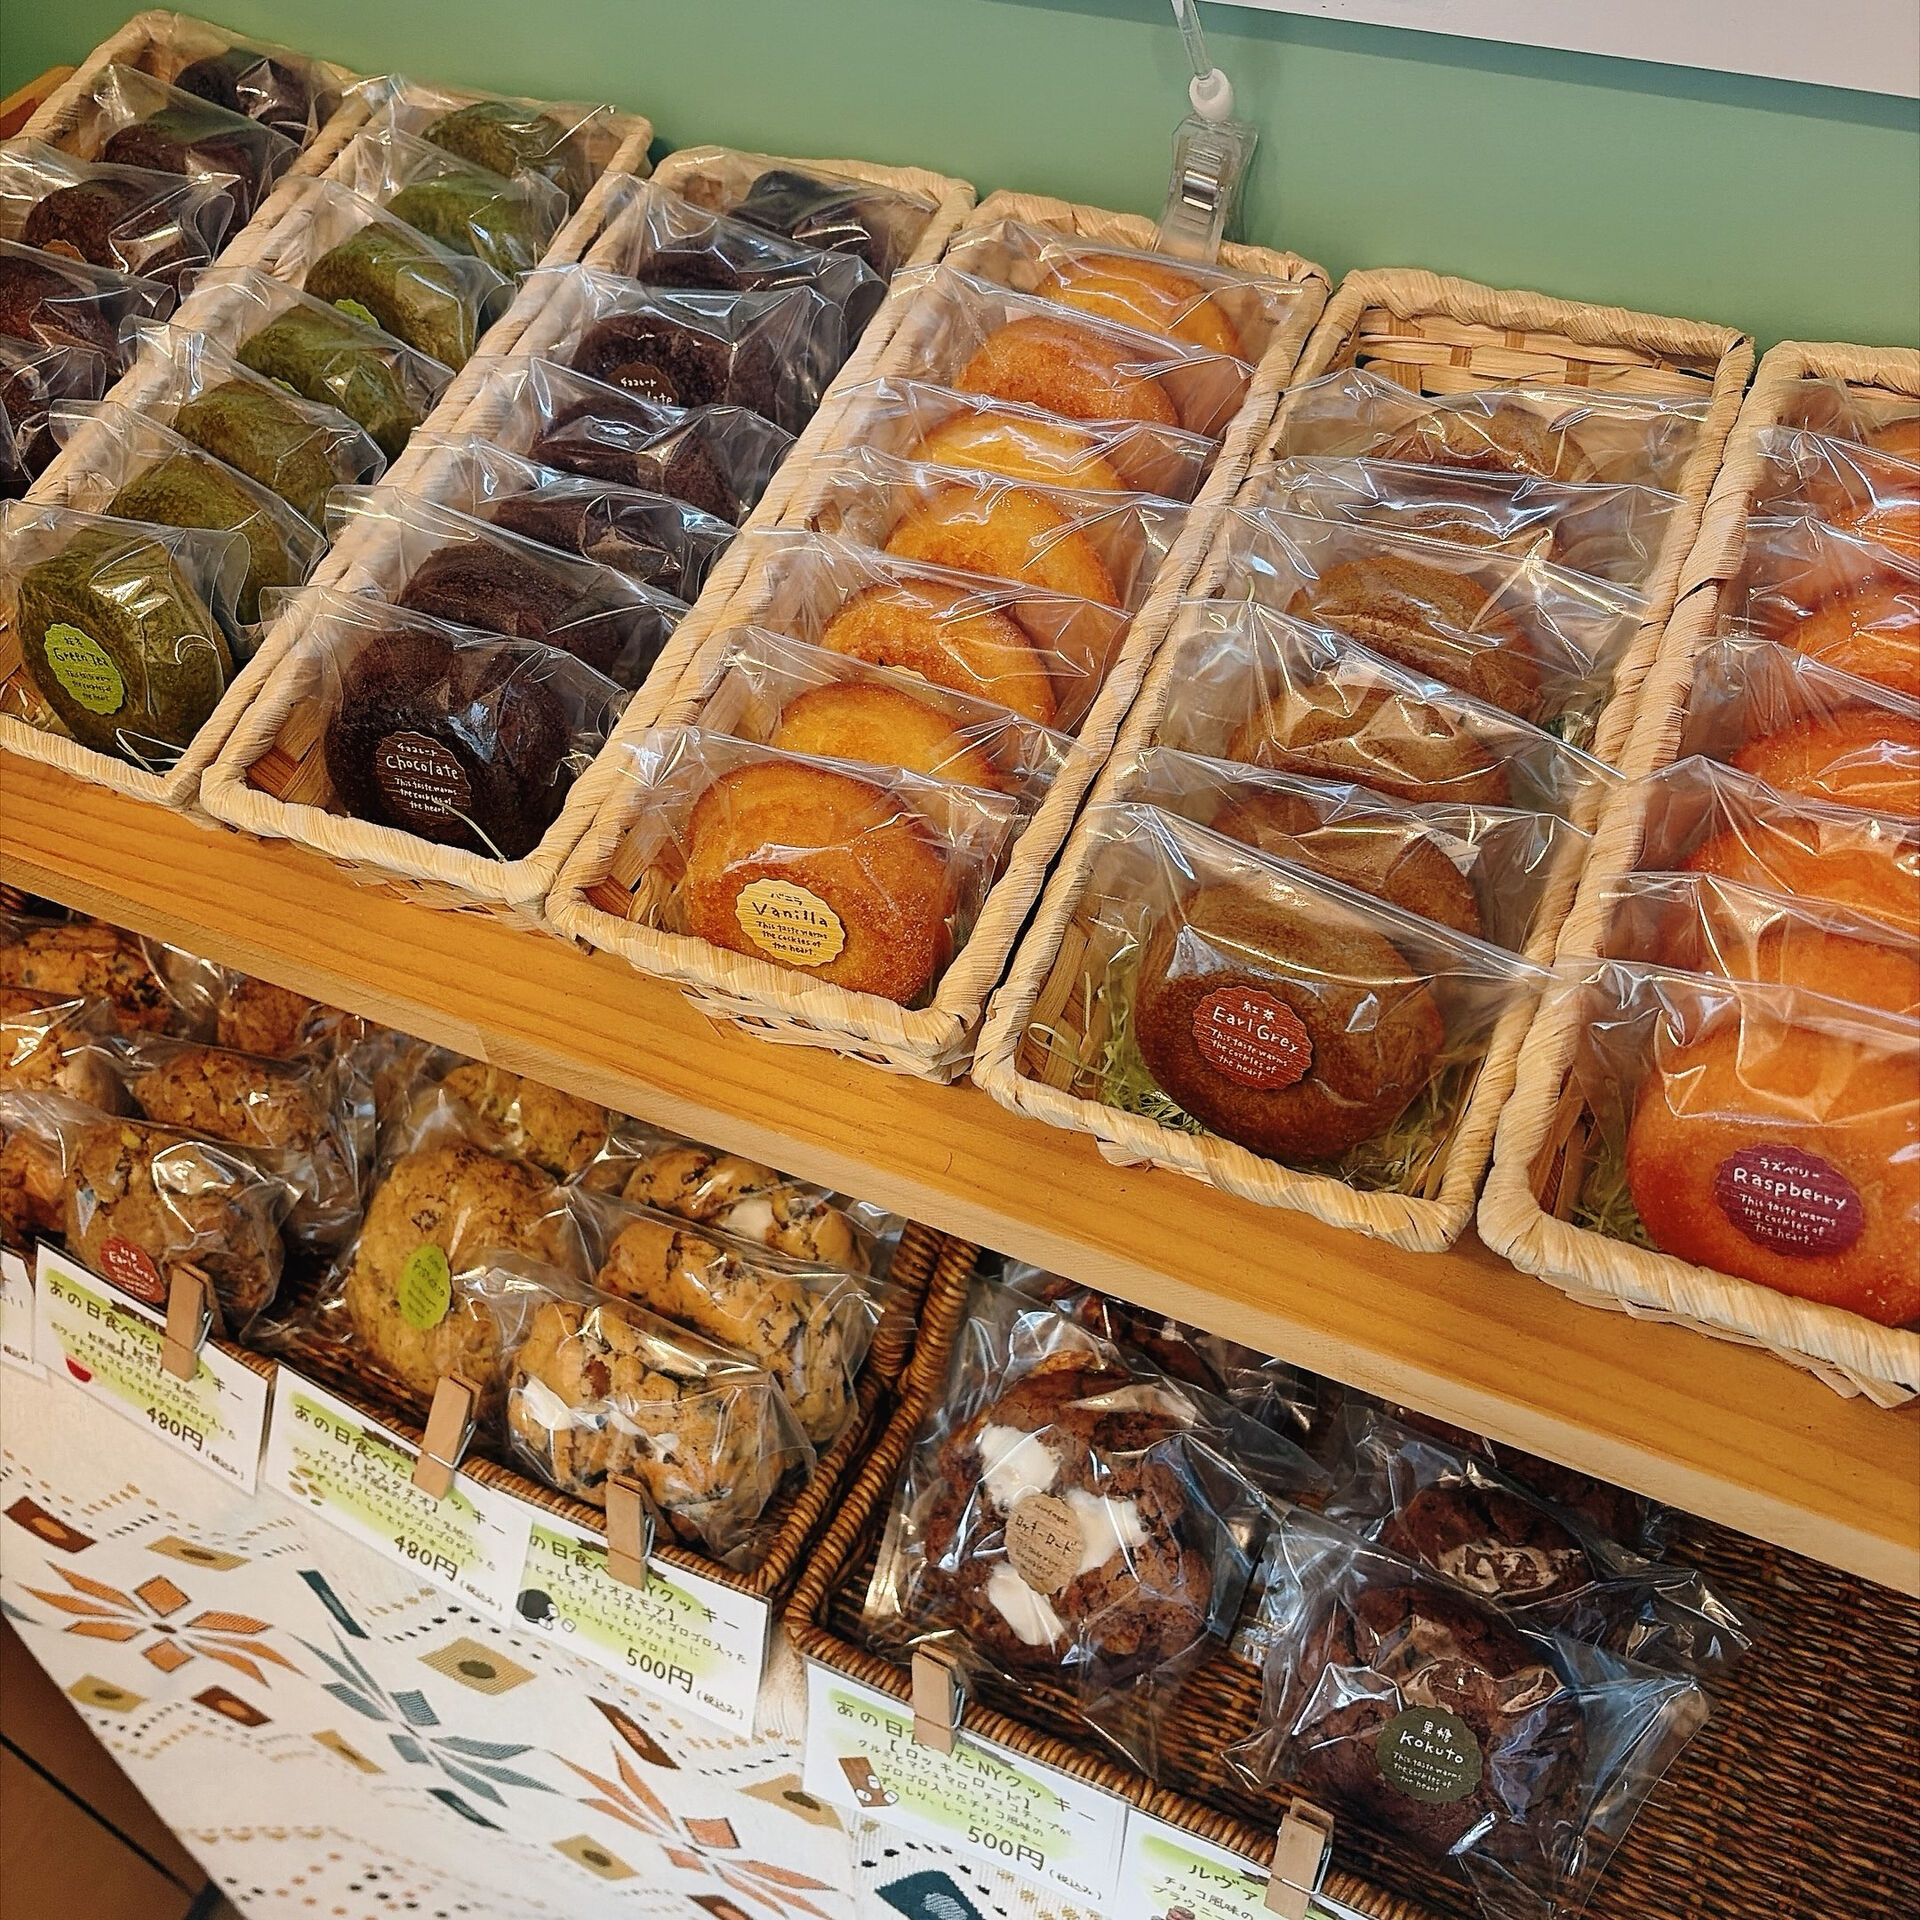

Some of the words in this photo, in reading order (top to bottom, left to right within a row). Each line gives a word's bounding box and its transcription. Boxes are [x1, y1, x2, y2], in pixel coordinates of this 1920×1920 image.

[53, 647, 87, 662] Green
[86, 651, 109, 667] Tea
[386, 755, 459, 780] Chocolate
[394, 777, 411, 787] This
[412, 781, 432, 791] taste
[433, 786, 457, 796] warms
[400, 788, 413, 798] the
[409, 800, 422, 810] the
[770, 892, 803, 906] バニラ
[752, 901, 828, 928] Vanilla
[756, 920, 775, 930] This
[777, 924, 799, 935] taste
[800, 929, 828, 940] warms
[762, 930, 775, 939] the
[778, 932, 811, 946] cockles
[812, 940, 821, 948] of
[772, 942, 786, 951] the
[1242, 1000, 1276, 1023] 紅茶
[1212, 1005, 1253, 1032] Earl
[1256, 1024, 1299, 1053] Grey
[1210, 1028, 1231, 1042] This
[1232, 1036, 1257, 1054] taste
[1259, 1049, 1288, 1067] warms
[1211, 1040, 1227, 1052] the
[1228, 1047, 1264, 1069] cockles
[1265, 1065, 1277, 1074] of
[1218, 1054, 1233, 1067] the
[1759, 1157, 1820, 1178] ラズベリー
[1733, 1166, 1847, 1210] Raspberry
[1740, 1193, 1764, 1207] This
[1767, 1200, 1796, 1216] taste
[1799, 1211, 1837, 1226] warms
[1744, 1207, 1761, 1219] the
[1764, 1213, 1808, 1233] cockles
[1812, 1226, 1825, 1236] of
[1754, 1222, 1773, 1235] the
[1777, 1229, 1814, 1246] heart.
[147, 1406, 204, 1451] 480円
[394, 1535, 458, 1581] 480円
[627, 1646, 693, 1694] 500円
[1421, 1720, 1453, 1744] 黒糖
[1399, 1730, 1464, 1764] Kokuto
[1393, 1751, 1410, 1763] This
[1412, 1759, 1434, 1771] taste
[1435, 1767, 1462, 1782] warms
[1393, 1762, 1407, 1773] the
[1408, 1769, 1440, 1785] cockles
[1442, 1780, 1452, 1789] of
[1399, 1775, 1413, 1784] the
[967, 1826, 1045, 1872] 500円
